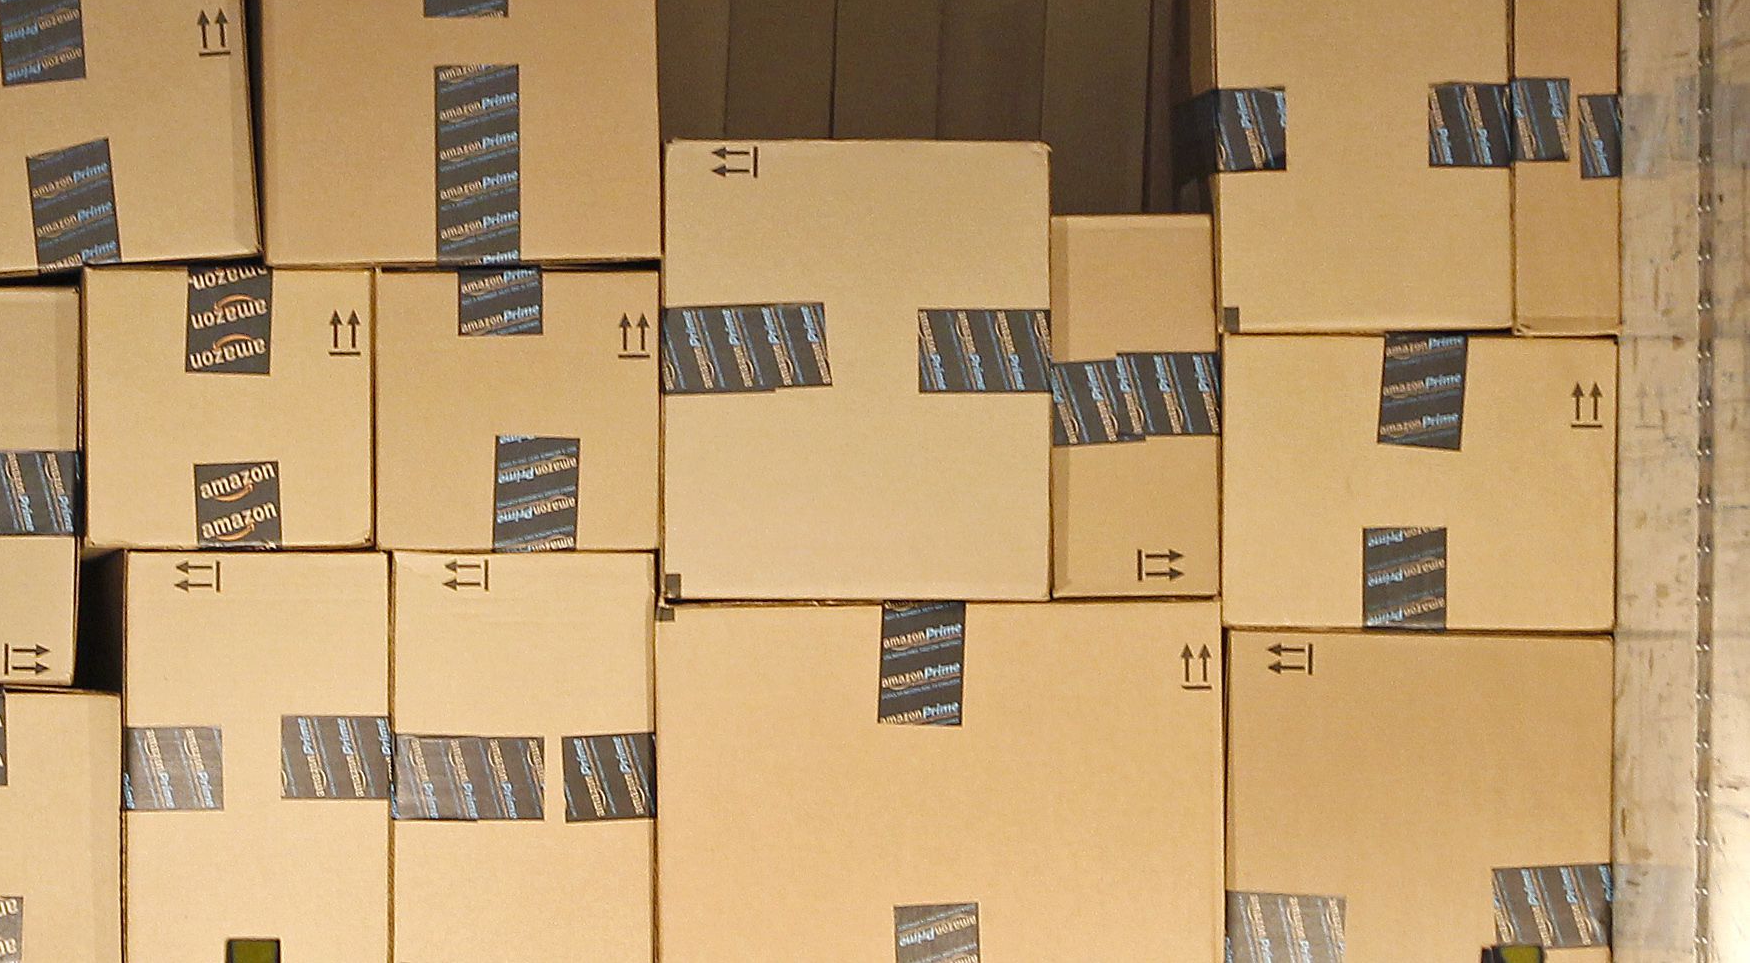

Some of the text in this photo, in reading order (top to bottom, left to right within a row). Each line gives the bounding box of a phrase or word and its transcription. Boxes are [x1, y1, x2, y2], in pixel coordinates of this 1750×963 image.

[440, 90, 518, 121] amazonPrime
[440, 130, 518, 160] amazonPrime
[32, 162, 108, 198] amazonPrime
[440, 170, 518, 201] amazonPrime
[37, 200, 112, 237] amazonPrime
[441, 209, 519, 241] amazonPrime
[191, 300, 267, 329] amazon
[462, 304, 539, 334] amazonPrime
[190, 338, 266, 369] amazon
[200, 463, 275, 499] amazon
[201, 502, 277, 538] amazon
[884, 623, 962, 649] amazonPrime
[882, 662, 960, 688] amazonPrime
